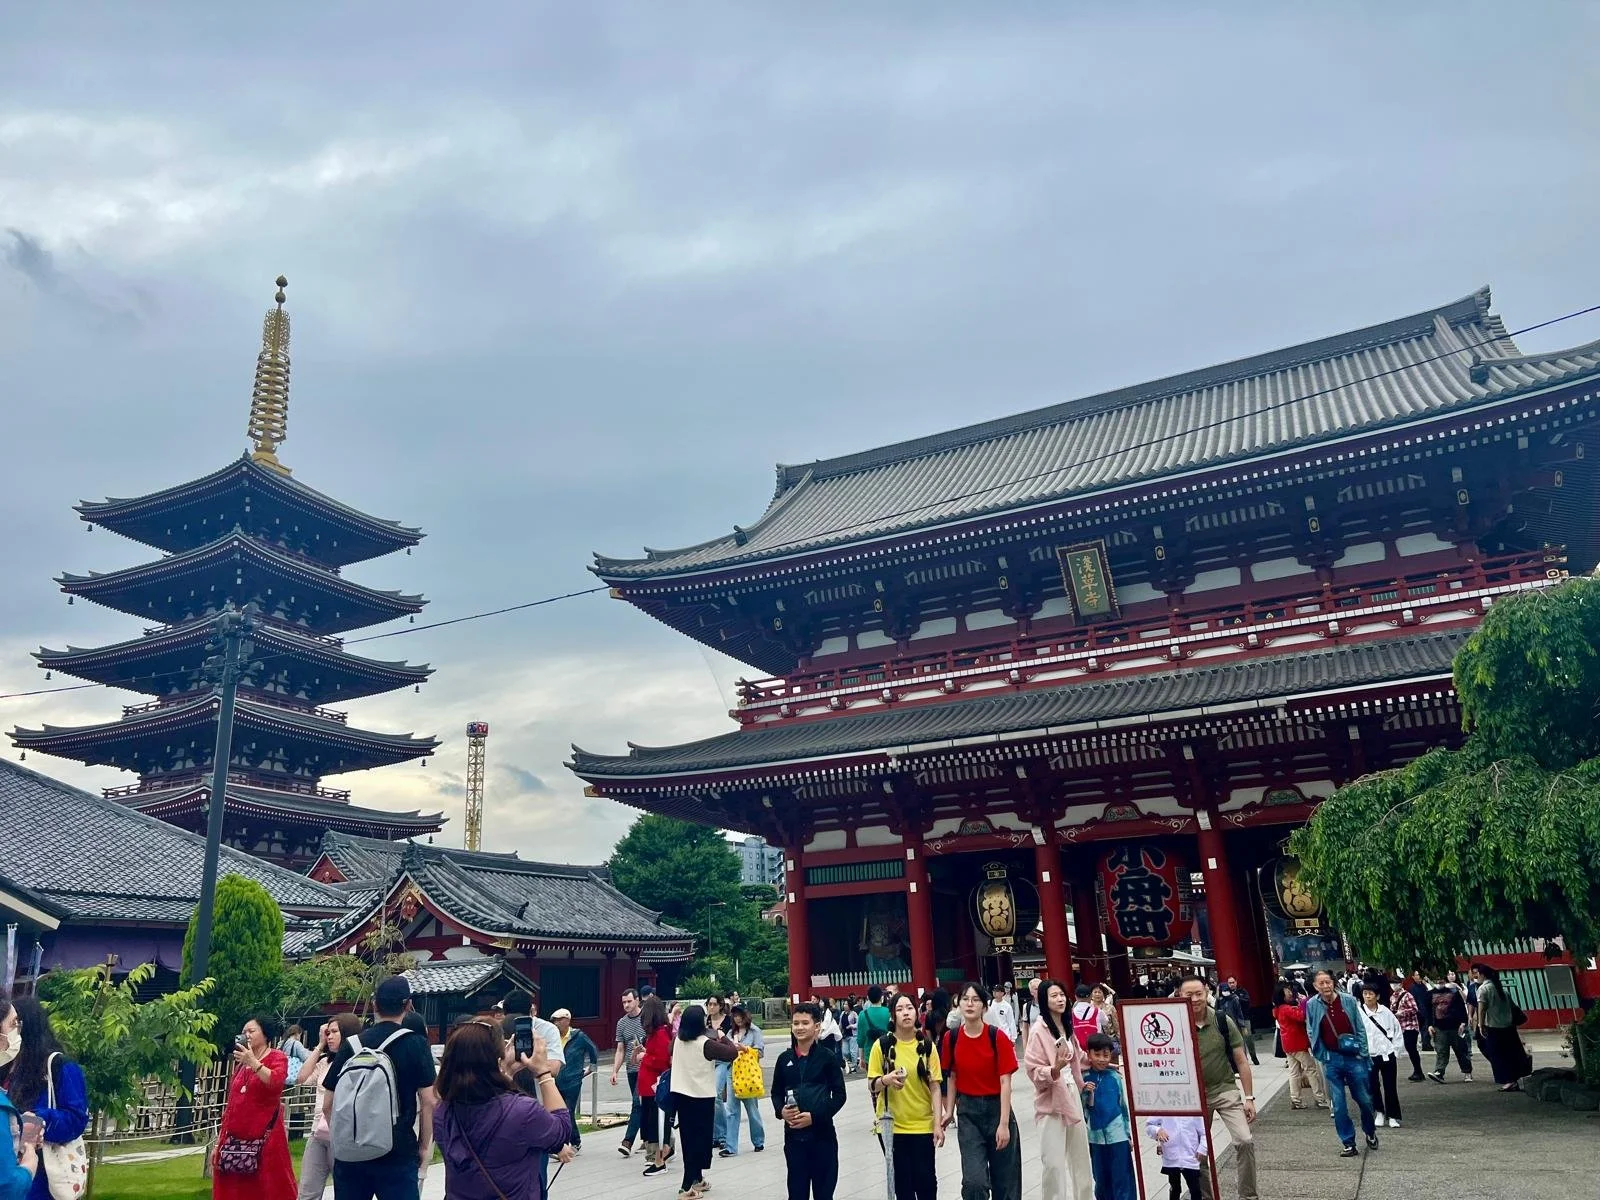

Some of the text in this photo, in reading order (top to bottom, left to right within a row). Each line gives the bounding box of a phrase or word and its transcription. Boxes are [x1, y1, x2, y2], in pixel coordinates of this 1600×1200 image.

[1137, 1047, 1182, 1055] 自転車進入禁止
[1136, 1089, 1197, 1106] 進入禁止
